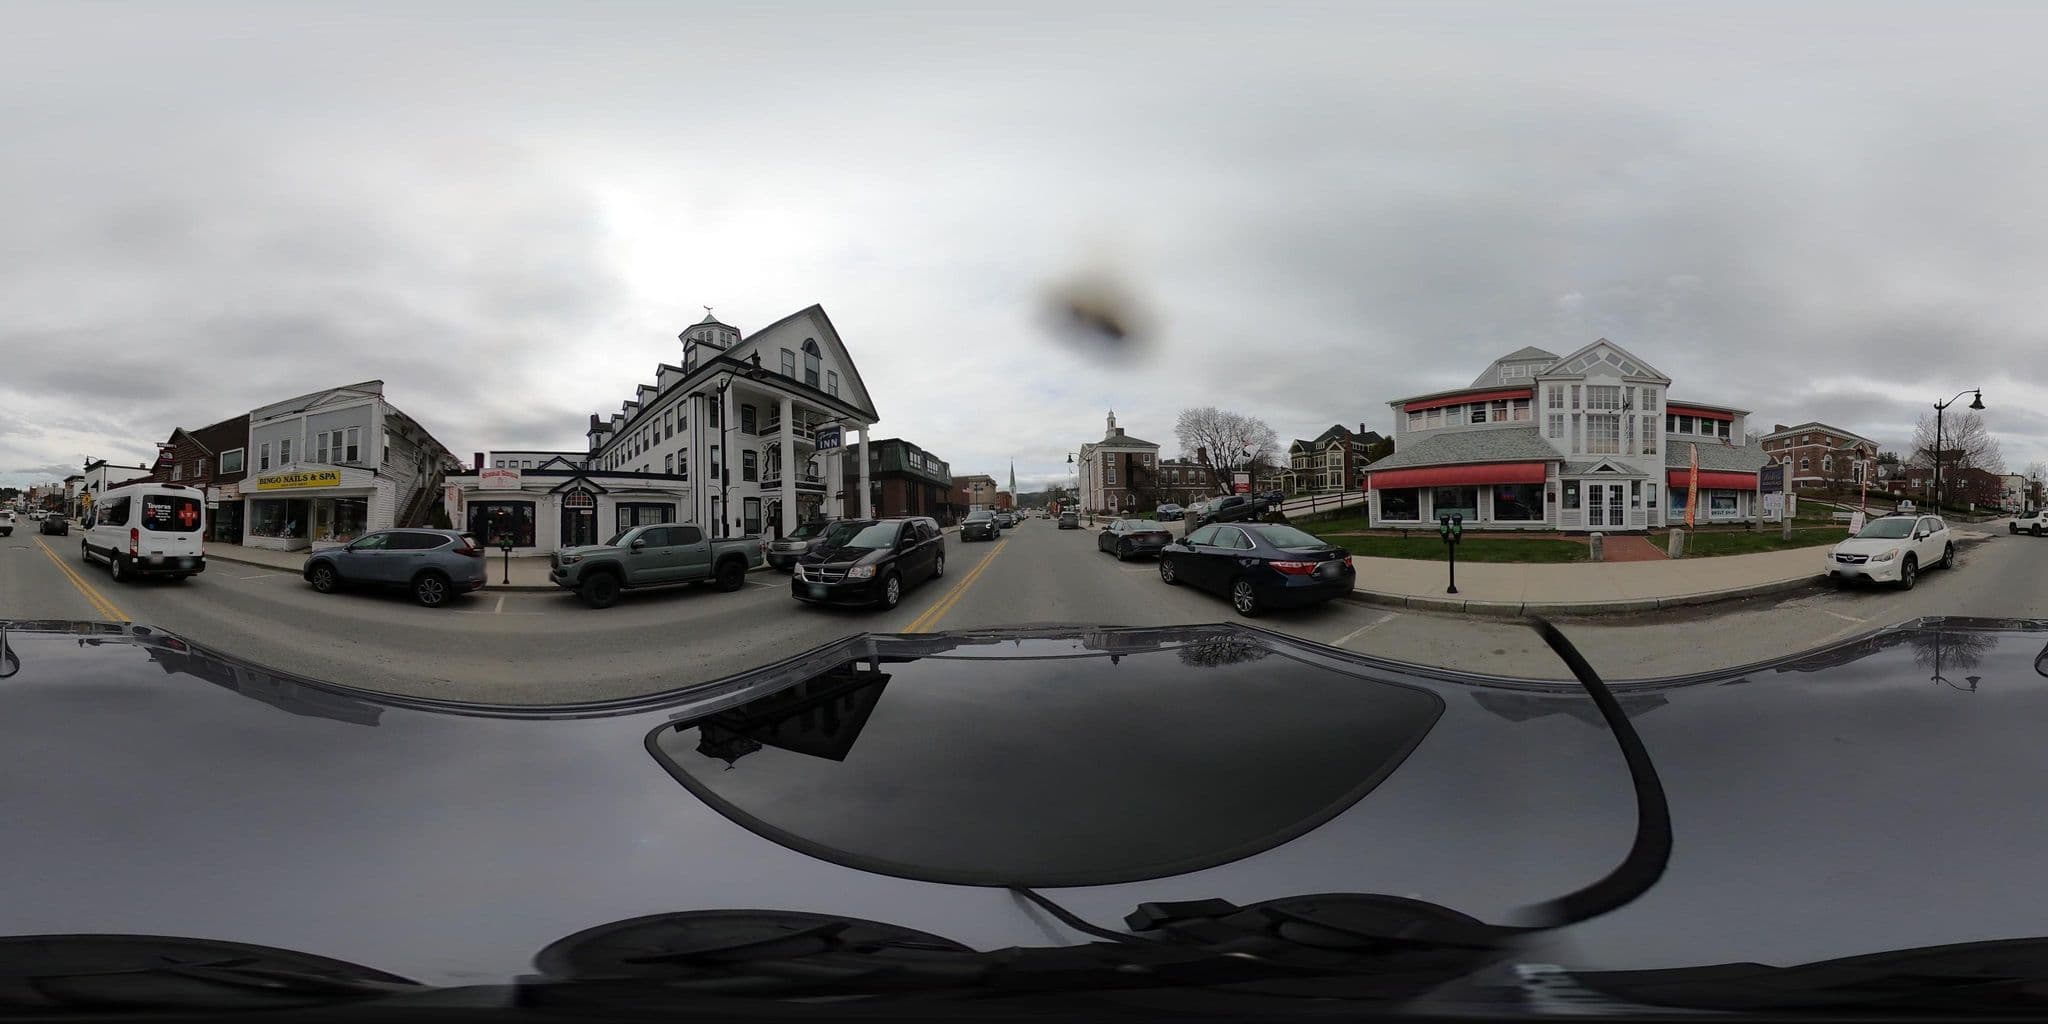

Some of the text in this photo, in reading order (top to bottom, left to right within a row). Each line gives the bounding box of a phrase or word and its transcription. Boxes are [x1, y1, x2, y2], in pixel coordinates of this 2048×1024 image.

[819, 438, 838, 448] INN
[284, 475, 308, 483] NAILS
[319, 472, 336, 480] SPA
